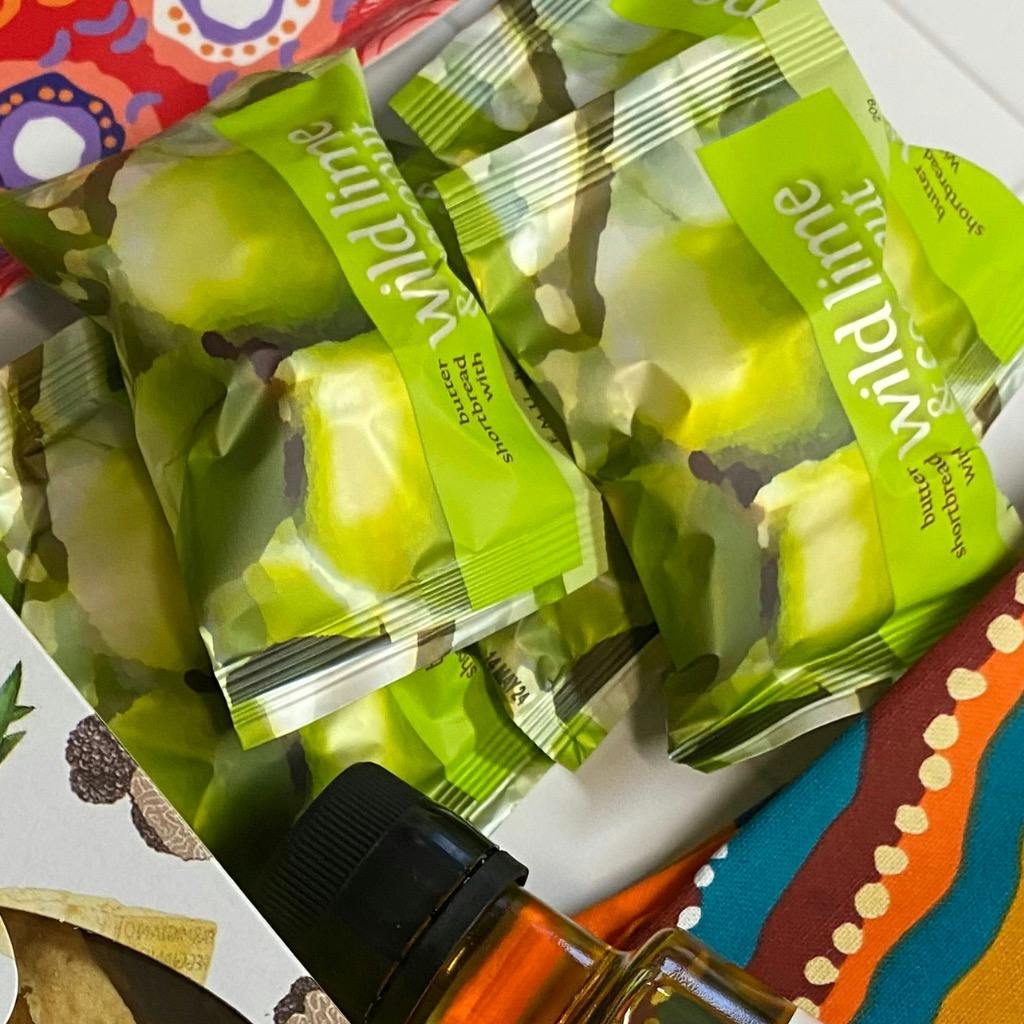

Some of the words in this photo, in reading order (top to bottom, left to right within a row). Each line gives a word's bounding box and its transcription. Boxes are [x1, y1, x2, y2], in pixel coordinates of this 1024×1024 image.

[287, 120, 391, 219] lime
[915, 164, 946, 222] butter
[923, 149, 986, 236] shortbread
[347, 212, 458, 350] wild
[774, 178, 883, 311] lime
[439, 358, 470, 426] butter
[452, 355, 514, 464] shortbread
[473, 352, 494, 402] with
[834, 300, 933, 460] wild
[926, 382, 956, 417] &
[907, 466, 936, 531] butter
[923, 453, 967, 559] shortbread
[511, 686, 532, 706] 24
